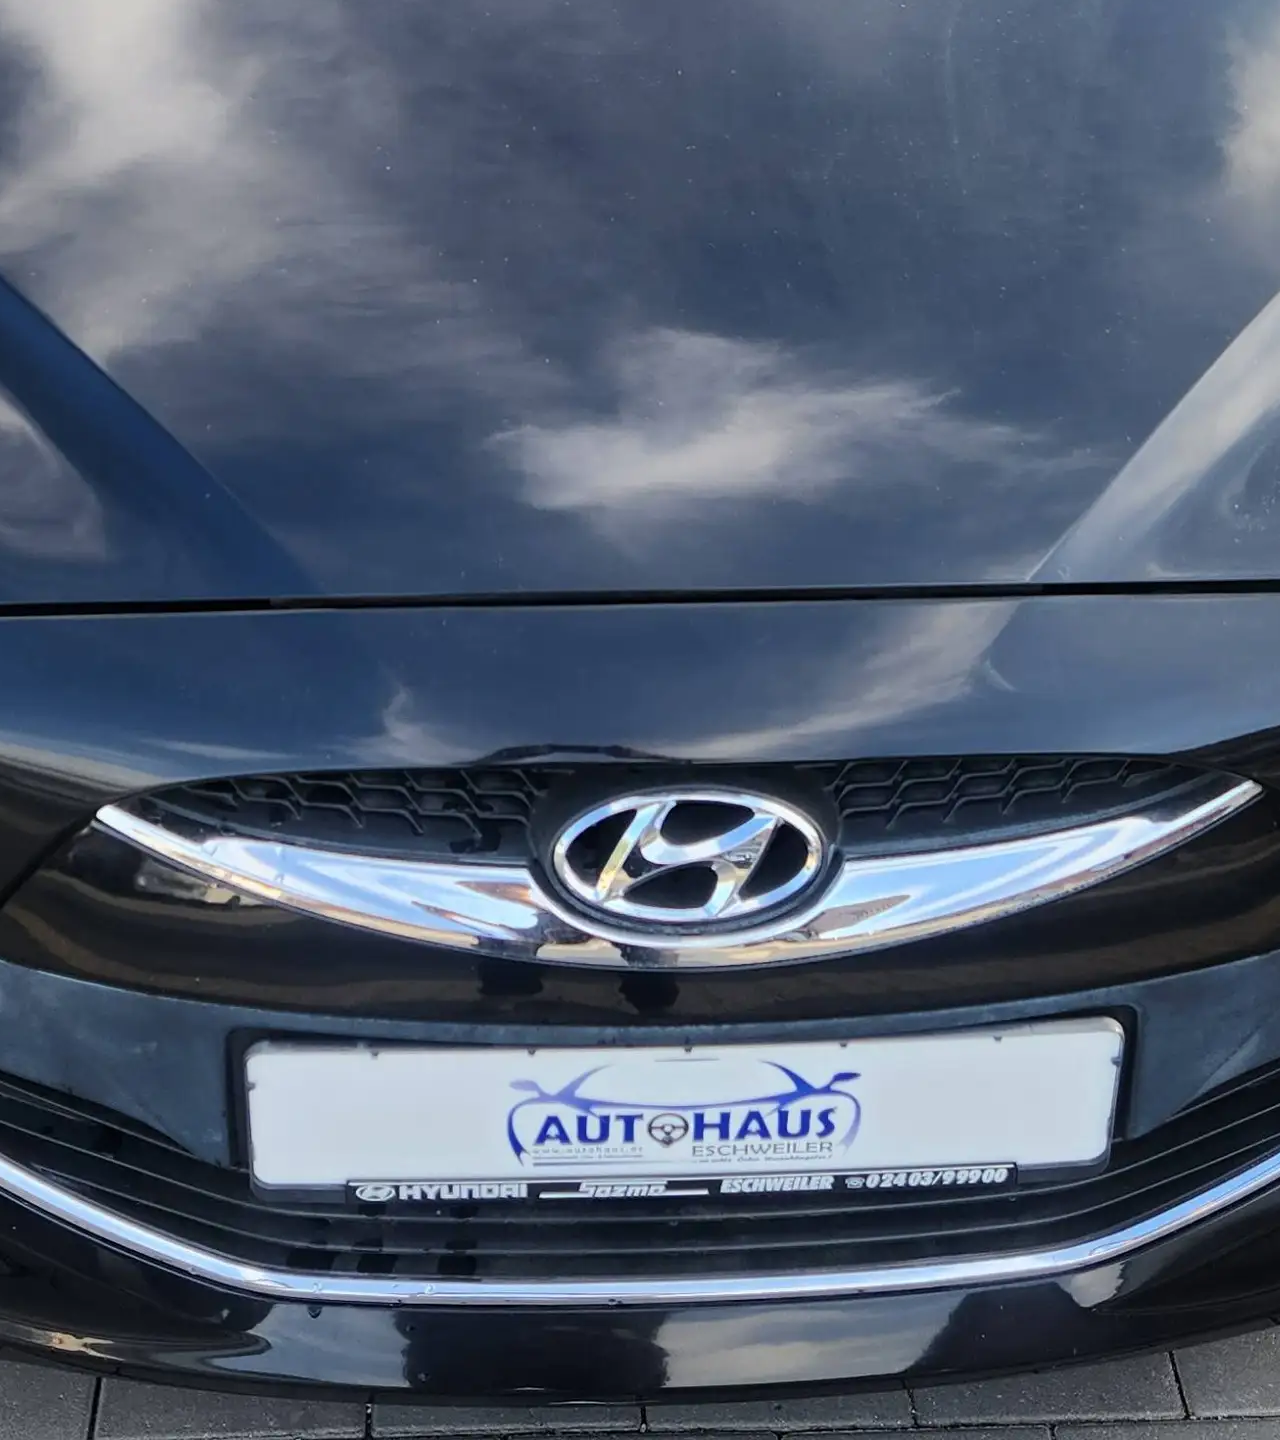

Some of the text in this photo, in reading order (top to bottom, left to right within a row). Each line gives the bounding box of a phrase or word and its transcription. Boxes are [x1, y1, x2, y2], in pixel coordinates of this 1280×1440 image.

[691, 1141, 834, 1158] ESCHWEILER
[398, 1183, 528, 1201] HYUNDAI
[719, 1175, 835, 1194] ESCHWEILER
[865, 1168, 1009, 1189] 02403/99900
